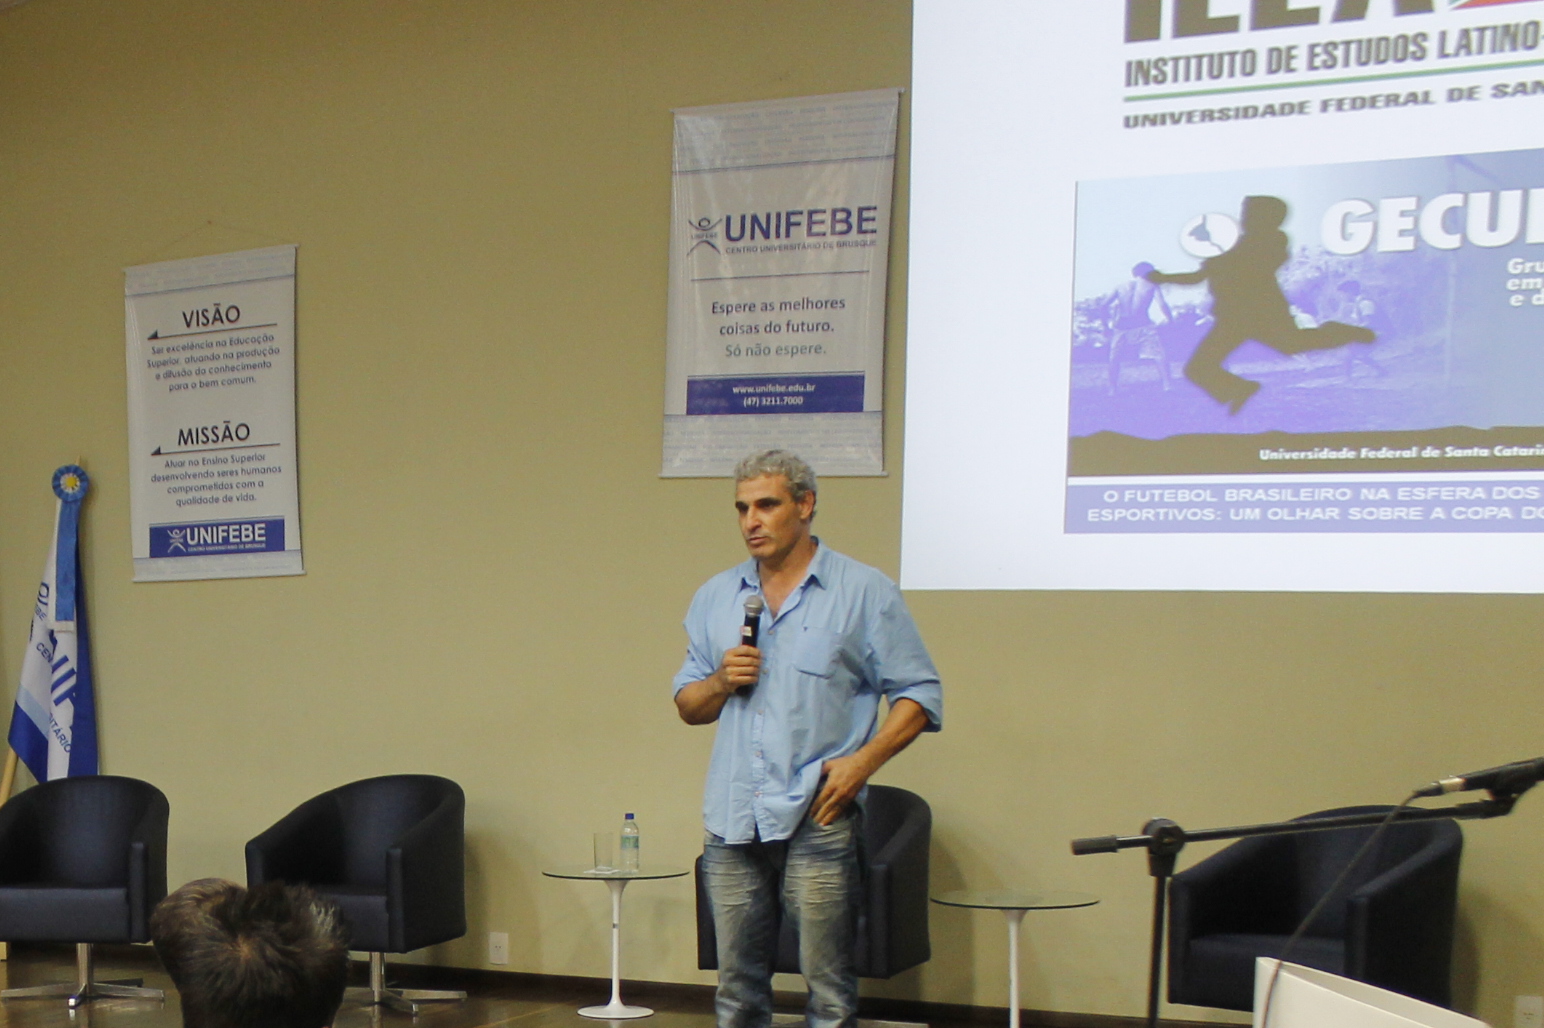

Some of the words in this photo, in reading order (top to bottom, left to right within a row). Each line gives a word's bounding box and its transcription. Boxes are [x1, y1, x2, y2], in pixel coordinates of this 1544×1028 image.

[1124, 48, 1257, 87] INSTITUTO
[1265, 45, 1299, 75] DE
[1306, 32, 1428, 71] ESTUDOS
[1437, 20, 1544, 59] LATINO
[1123, 100, 1312, 129] UNIVERSIDADE
[1319, 90, 1436, 113] FEDERAL
[1446, 85, 1481, 103] DE
[725, 205, 878, 242] UNIFEBE
[725, 246, 758, 255] CENTRO
[760, 241, 821, 253] UNIVERSITÁRIO
[822, 240, 834, 249] DE
[836, 238, 877, 249] BRUSQUE
[712, 301, 756, 316] Espere
[760, 301, 775, 312] as
[779, 296, 846, 311] melhores
[1509, 294, 1524, 307] e
[182, 302, 241, 328] VISÃO
[720, 321, 760, 336] coisas
[764, 320, 782, 334] do
[786, 319, 835, 334] futuro.
[166, 340, 213, 354] excelência
[229, 333, 275, 346] Educação
[725, 343, 742, 357] Só
[746, 342, 771, 357] não
[775, 343, 827, 358] espere.
[184, 353, 220, 364] atuando
[223, 351, 234, 360] na
[236, 346, 280, 360] produção
[209, 360, 272, 374] conhecimento
[169, 383, 189, 393] para
[199, 377, 219, 388] bem
[732, 383, 816, 394] www.unifebe.edu.br
[743, 396, 760, 408] (47)
[177, 420, 250, 446] MISSÃO
[165, 459, 186, 469] Atuar
[188, 458, 200, 467] no
[202, 456, 228, 466] Ensino
[231, 453, 266, 465] Superior
[1259, 447, 1356, 461] Universidade
[1360, 446, 1418, 459] Federal
[1420, 445, 1442, 458] de
[1444, 446, 1490, 458] Santa
[151, 469, 215, 483] desenvolvendo
[217, 468, 239, 478] seres
[241, 465, 282, 476] humanos
[167, 481, 233, 495] comprometidos
[236, 480, 256, 489] com
[1103, 490, 1119, 503] O
[1124, 489, 1218, 503] FUTEBOL
[1224, 488, 1352, 502] BRASILEIRO
[1359, 487, 1391, 501] NA
[1396, 486, 1487, 501] ESFERA
[1492, 486, 1541, 500] DOS
[176, 495, 220, 508] qualidade
[222, 493, 234, 503] de
[236, 492, 257, 502] vida.
[1087, 508, 1222, 522] ESPORTIVOS:
[1229, 507, 1261, 521] UM
[1267, 507, 1340, 521] OLHAR
[1348, 507, 1425, 520] SOBRE
[1429, 507, 1446, 520] A
[1451, 506, 1513, 520] COPA
[186, 523, 267, 546] UNIFEBE
